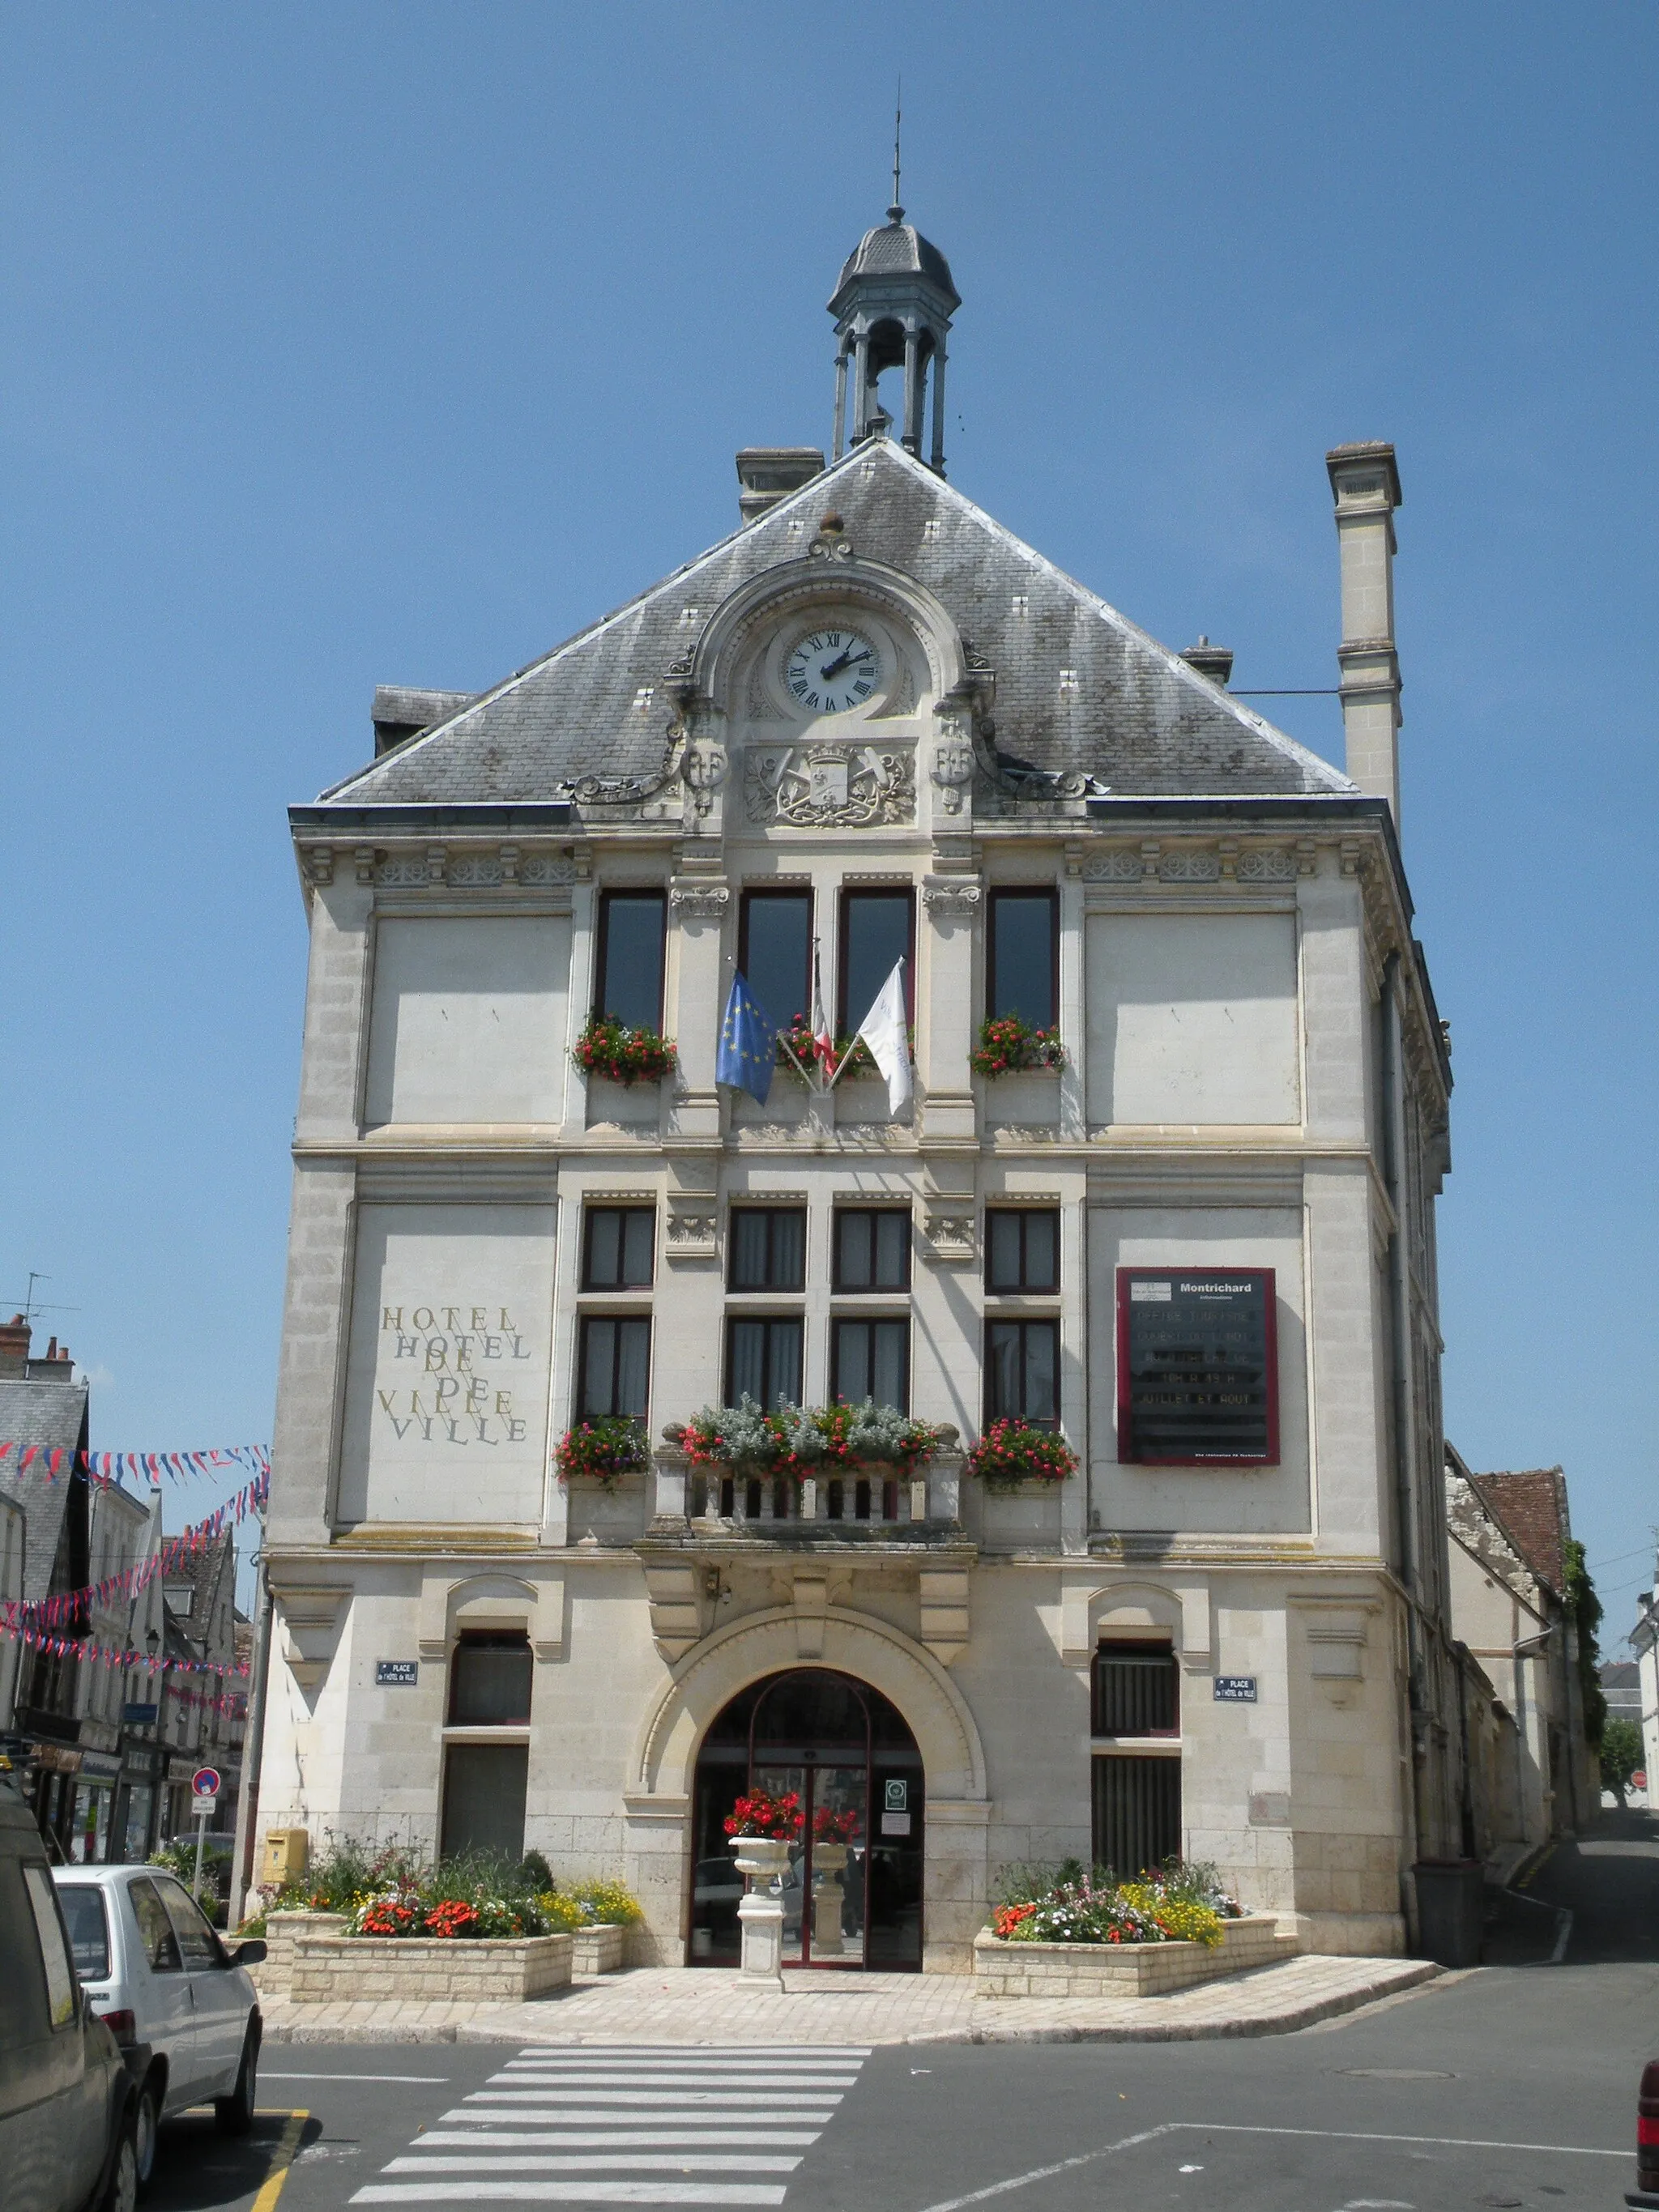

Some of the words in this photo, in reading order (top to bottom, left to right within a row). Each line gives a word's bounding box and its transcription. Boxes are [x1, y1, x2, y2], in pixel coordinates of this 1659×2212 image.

[809, 637, 823, 652] XI
[827, 633, 840, 647] XII
[795, 650, 810, 662] X
[790, 667, 805, 676] IX
[859, 667, 875, 676] III
[825, 697, 836, 711] VI
[845, 694, 855, 707] V
[1180, 1282, 1252, 1293] Montrichard
[381, 1306, 517, 1331] HOTEL
[423, 1348, 475, 1372] DE
[377, 1389, 515, 1415] VILLE
[1230, 1680, 1248, 1688] PLACE
[1243, 1690, 1254, 1698] VILLE
